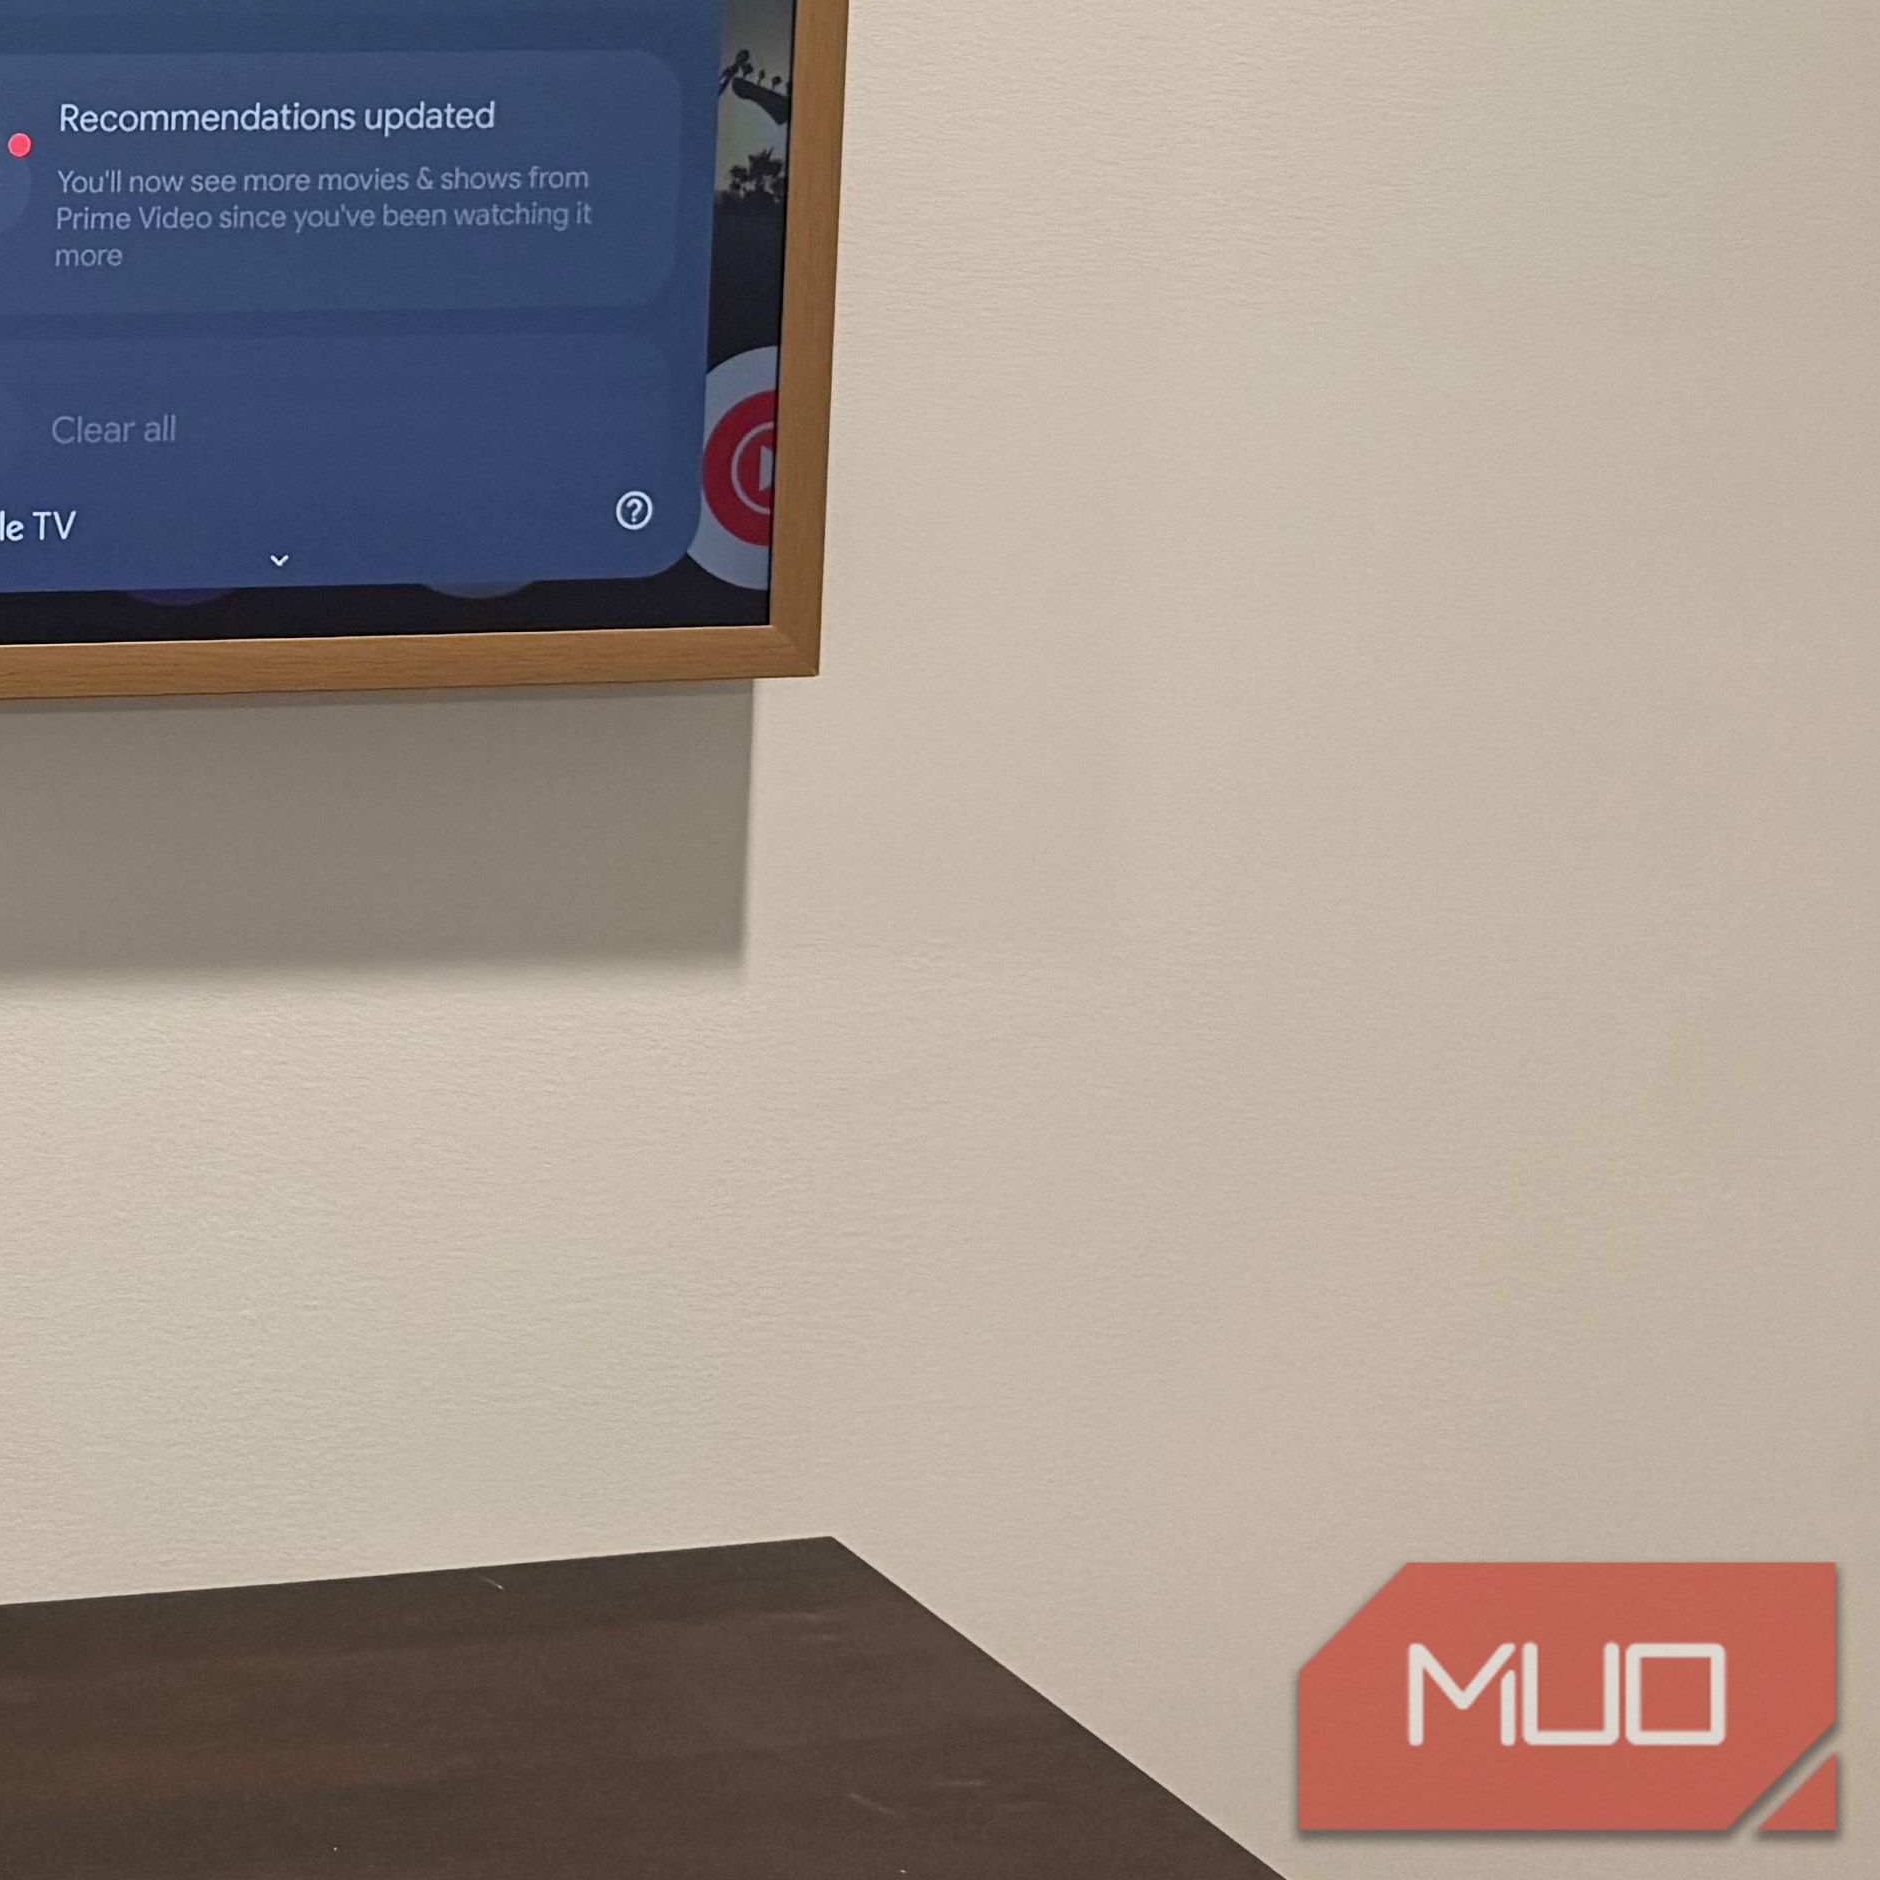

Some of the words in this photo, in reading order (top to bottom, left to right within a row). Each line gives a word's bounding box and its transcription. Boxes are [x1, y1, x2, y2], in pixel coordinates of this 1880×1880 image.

[60, 102, 355, 132] Recommendations
[363, 101, 495, 137] updated
[57, 168, 122, 194] You'll
[129, 173, 182, 194] now
[190, 173, 237, 193] see
[243, 172, 311, 193] more
[318, 167, 409, 191] movies
[416, 166, 435, 191] &
[441, 166, 522, 191] shows
[528, 165, 589, 190] from
[56, 205, 131, 231] Prime
[138, 204, 212, 230] Video
[219, 203, 286, 229] since
[294, 203, 377, 233] you've
[382, 202, 446, 227] been
[452, 200, 568, 232] watching
[575, 199, 593, 225] it
[54, 247, 123, 267] more
[51, 414, 135, 445] Clear
[143, 412, 177, 444] all
[33, 511, 77, 541] TV
